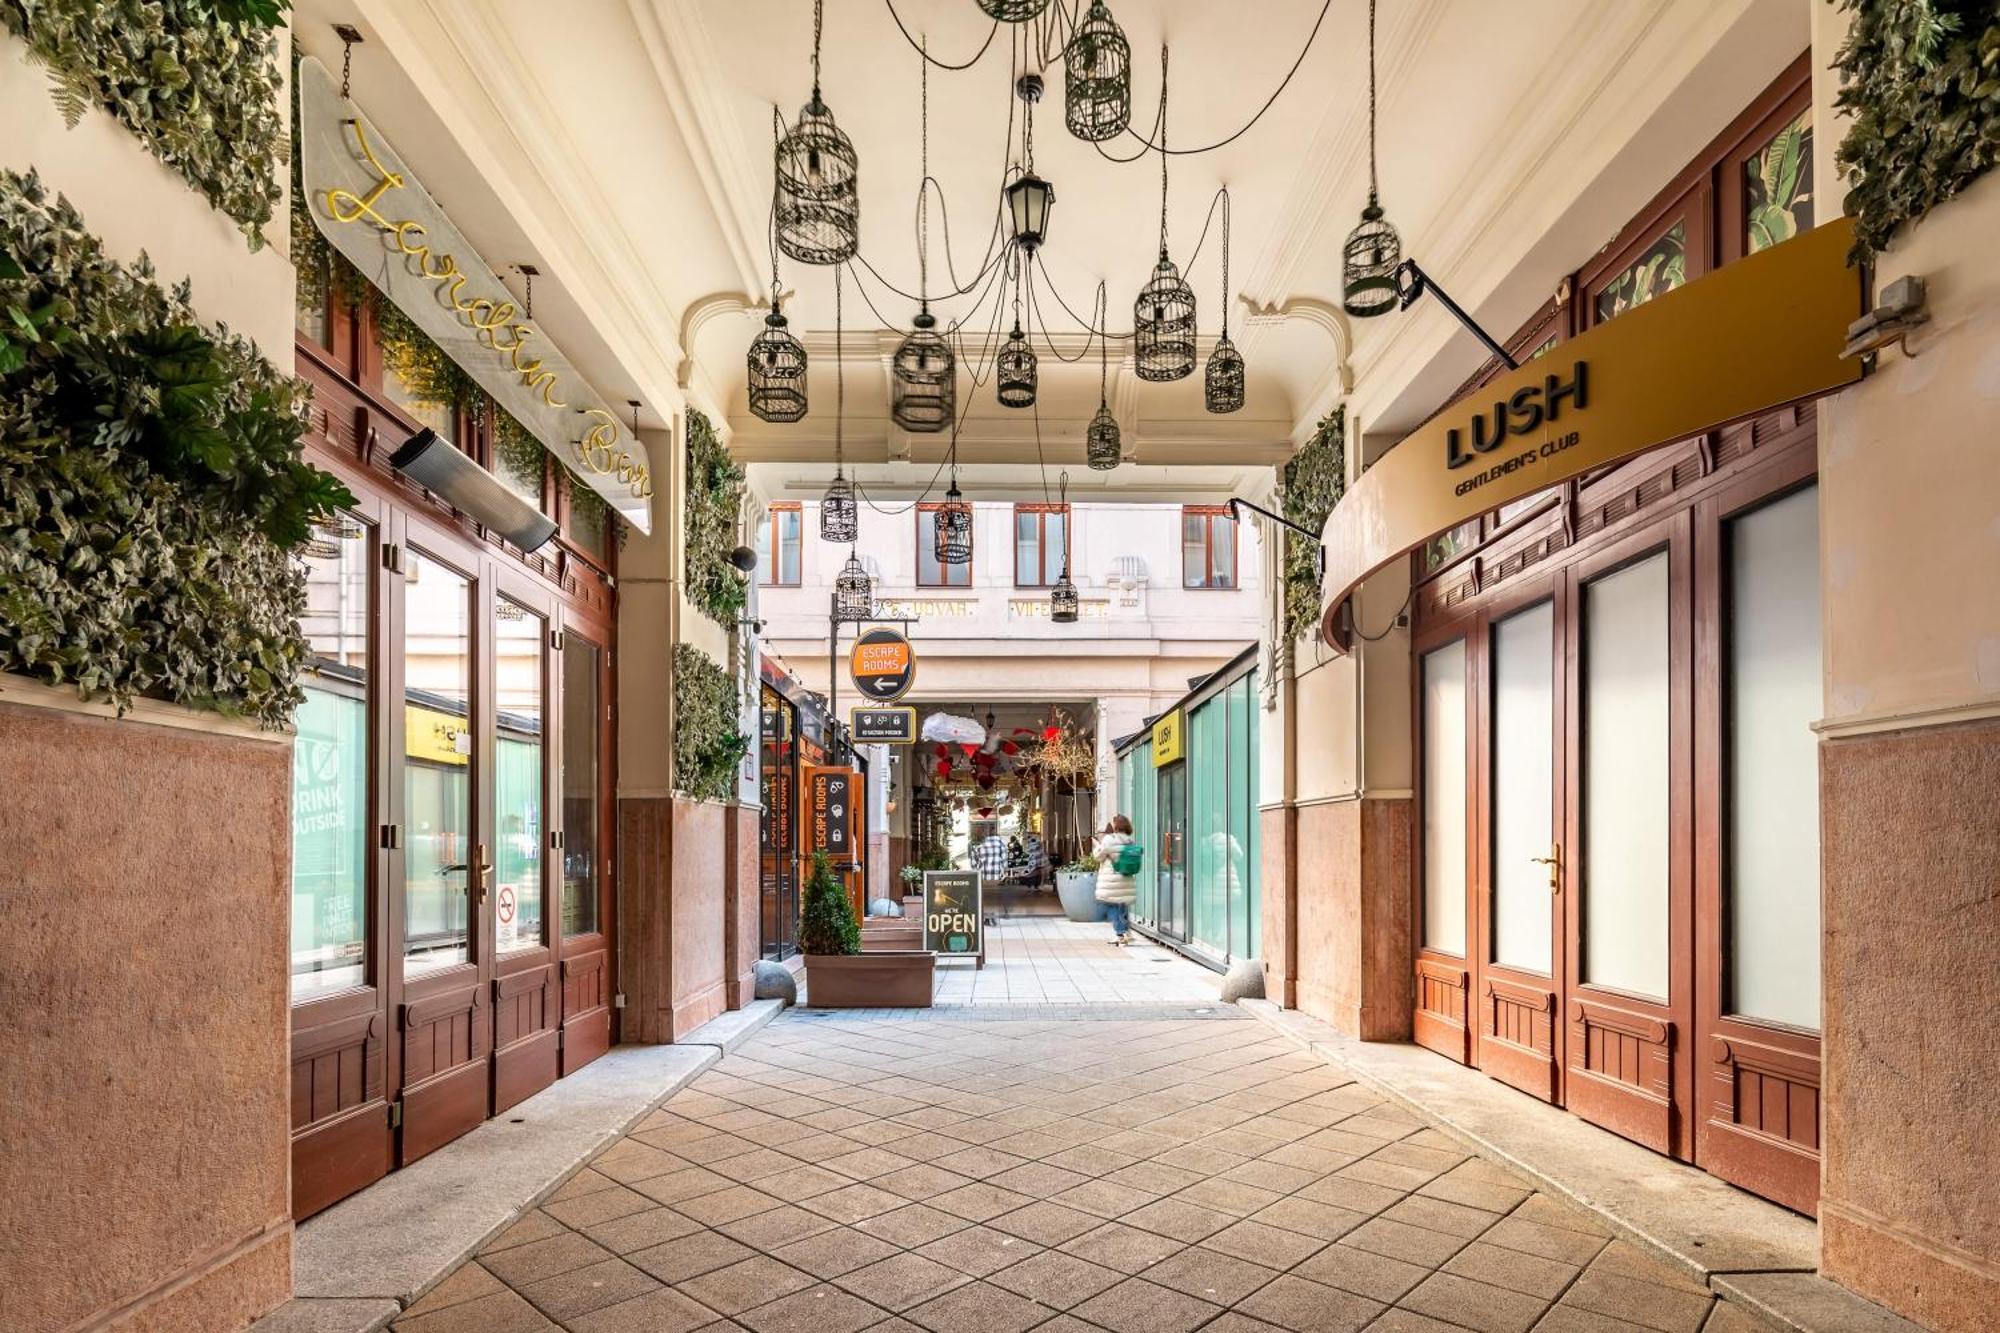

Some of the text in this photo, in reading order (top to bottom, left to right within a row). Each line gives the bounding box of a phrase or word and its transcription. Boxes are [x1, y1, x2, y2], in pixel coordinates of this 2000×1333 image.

[1447, 361, 1588, 469] LUSH
[1455, 431, 1580, 497] GENTLEMEN'S CLUB
[863, 646, 901, 658] ESCAPE
[863, 660, 899, 671] ROOMS
[815, 776, 827, 848] ESCAPE ROOMS
[928, 913, 976, 933] OPEN
